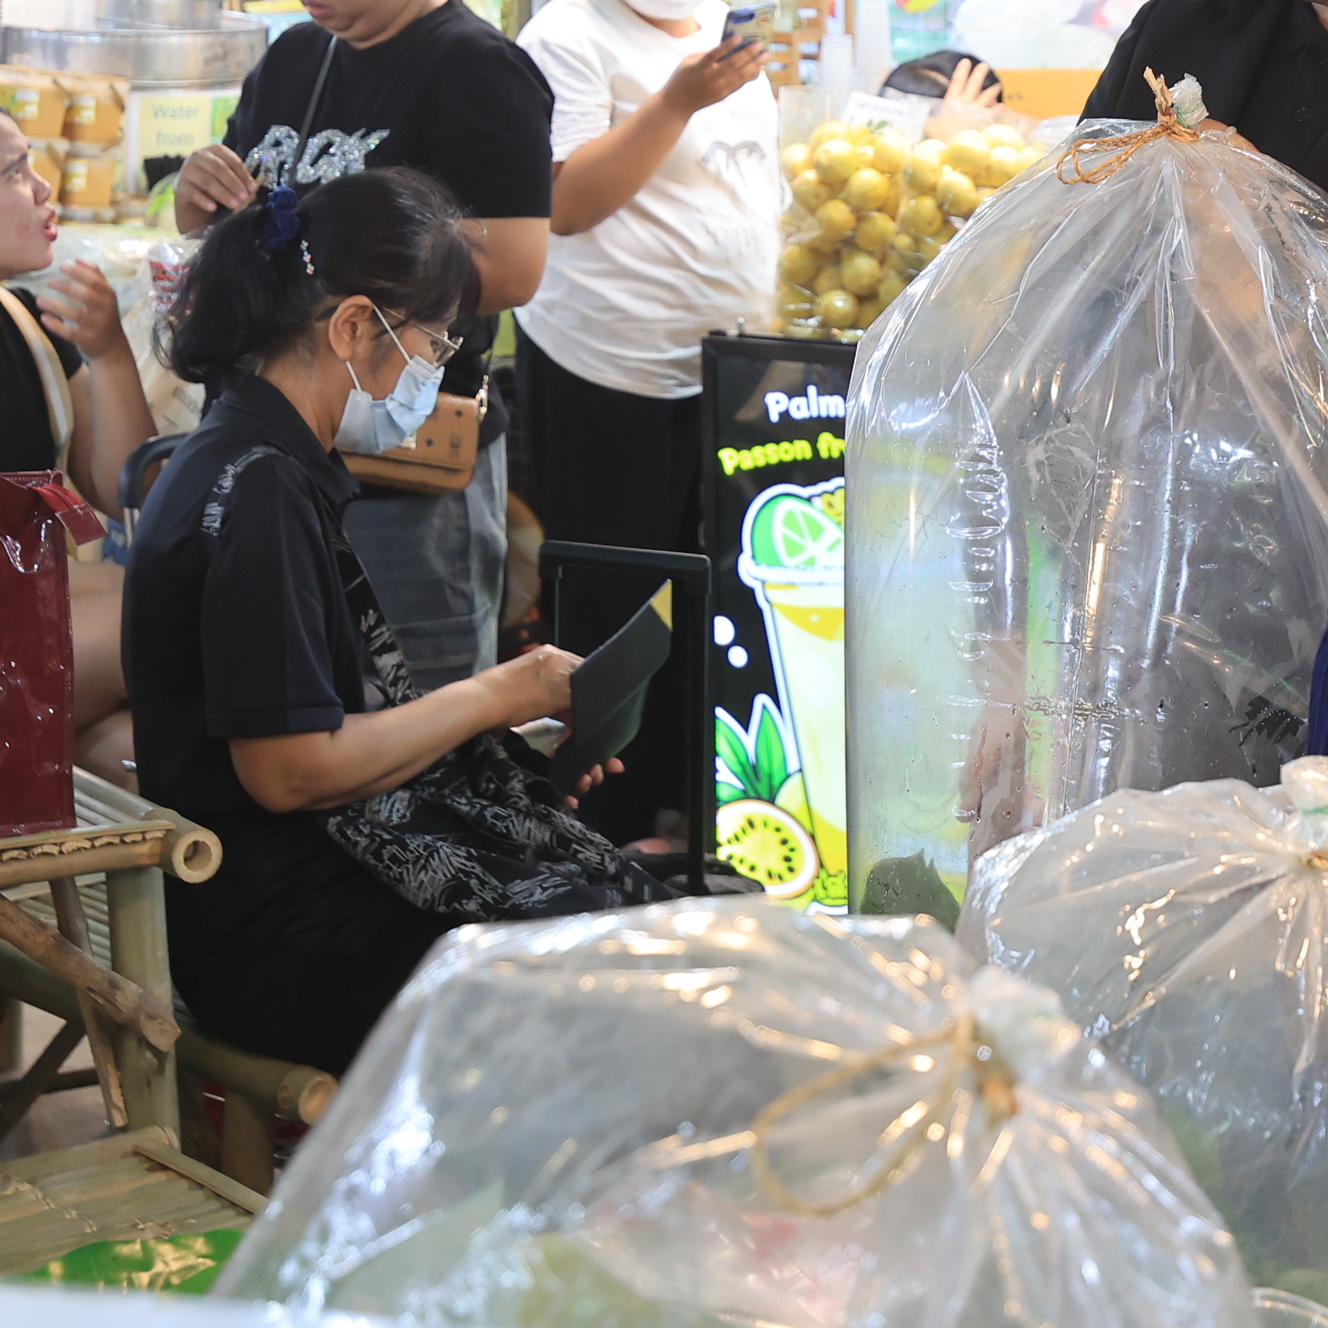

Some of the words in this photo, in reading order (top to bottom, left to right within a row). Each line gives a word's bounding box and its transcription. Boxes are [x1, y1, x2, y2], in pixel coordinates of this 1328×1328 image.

[764, 384, 845, 423] Palm
[717, 438, 813, 476] Passon
[816, 431, 845, 459] fr
